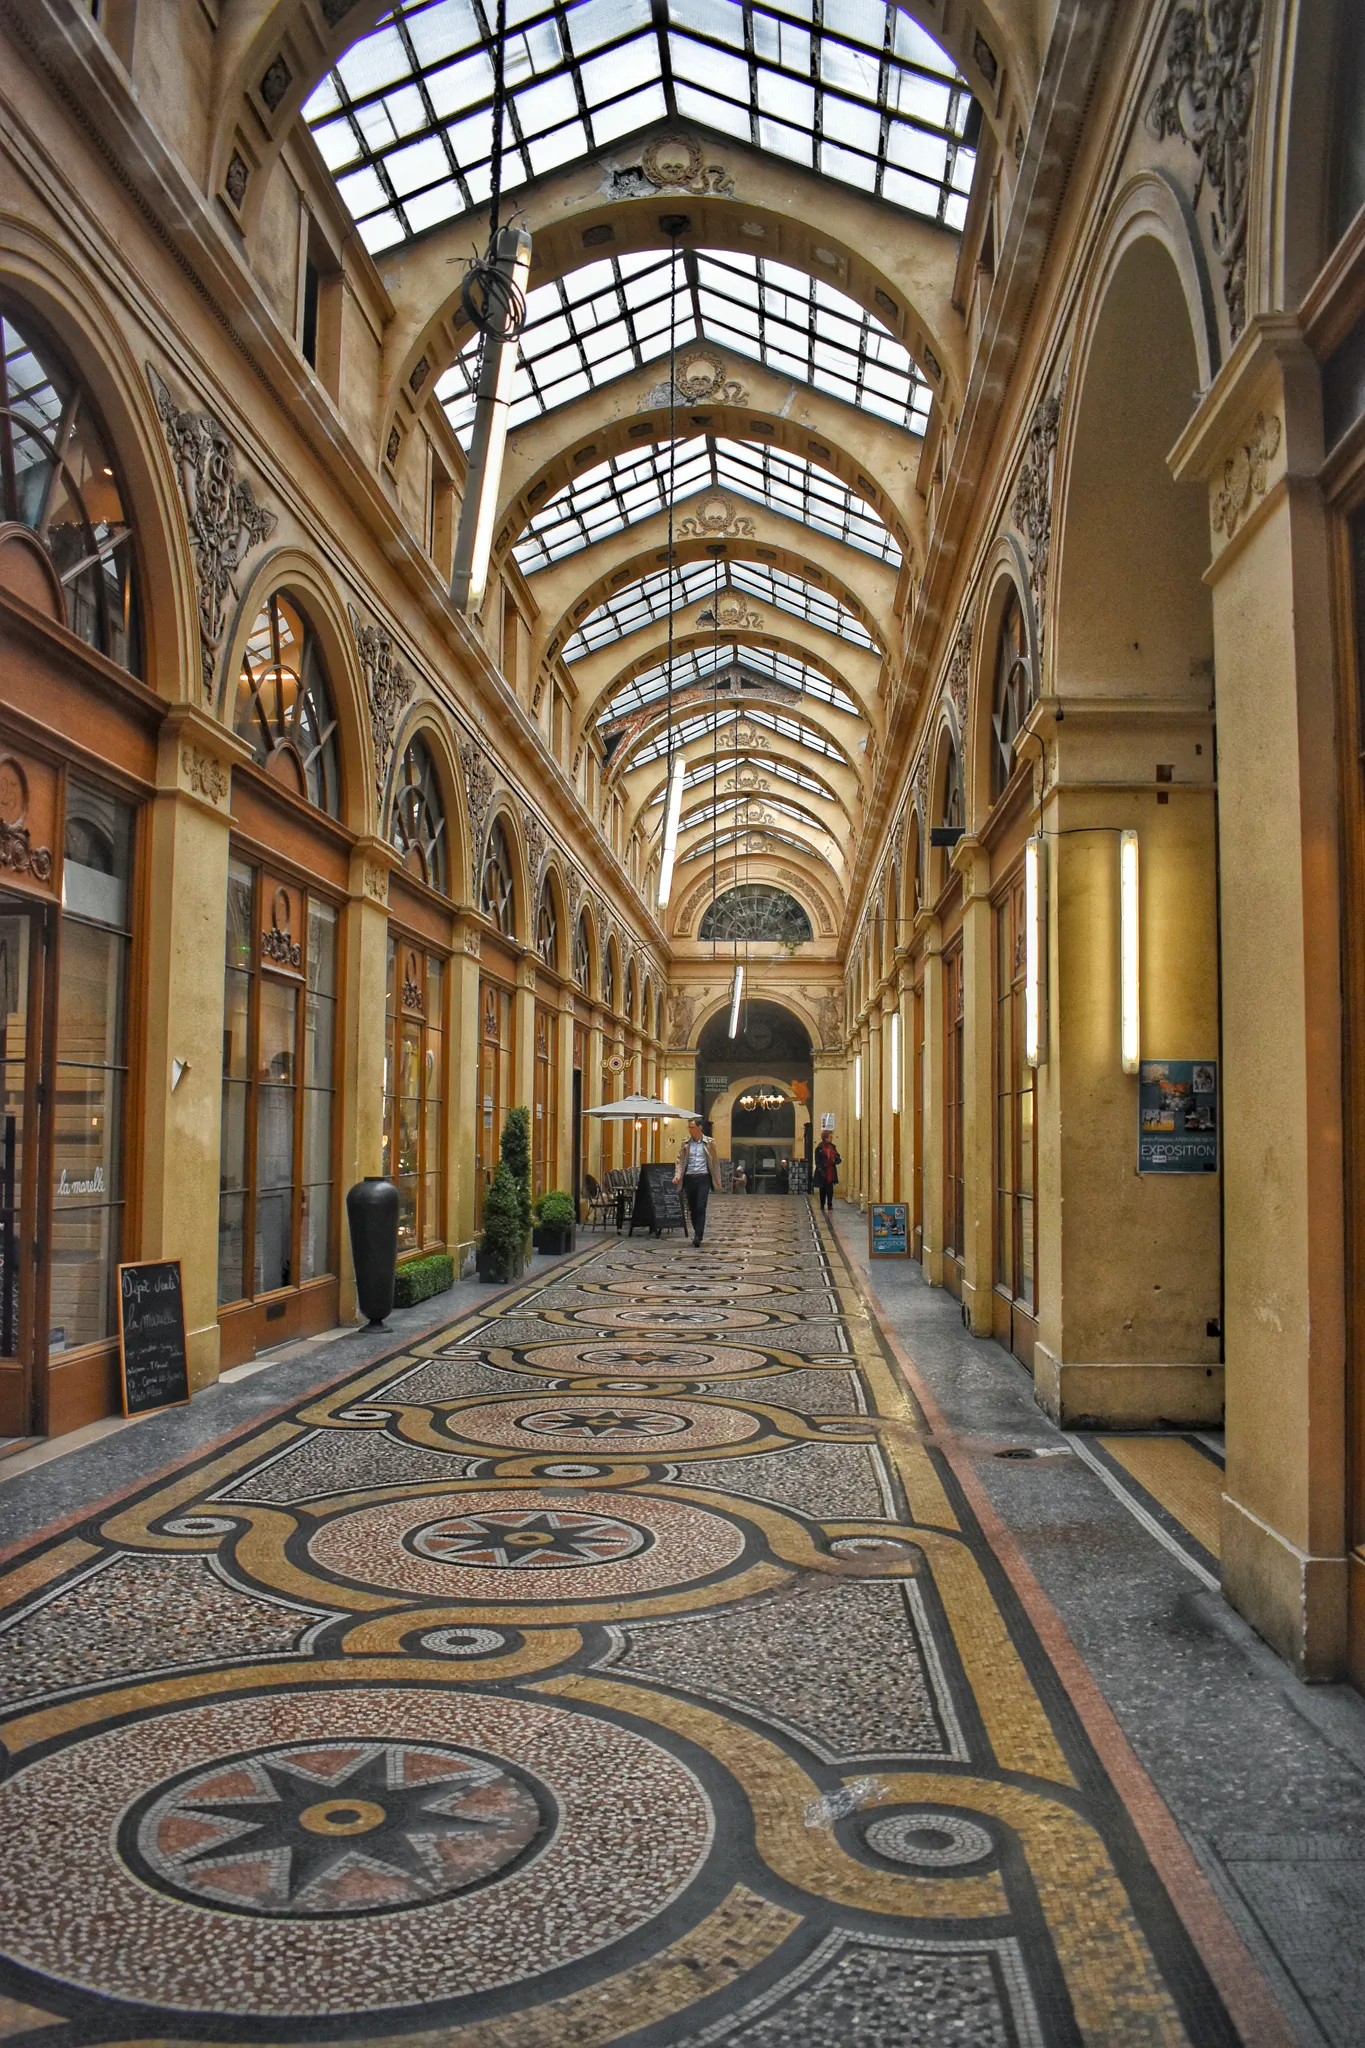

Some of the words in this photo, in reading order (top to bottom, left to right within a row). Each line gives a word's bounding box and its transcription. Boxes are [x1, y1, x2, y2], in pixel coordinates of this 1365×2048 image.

[1141, 1144, 1215, 1156] EXPOSITION
[57, 1168, 71, 1195] la
[71, 1166, 106, 1193] marelle
